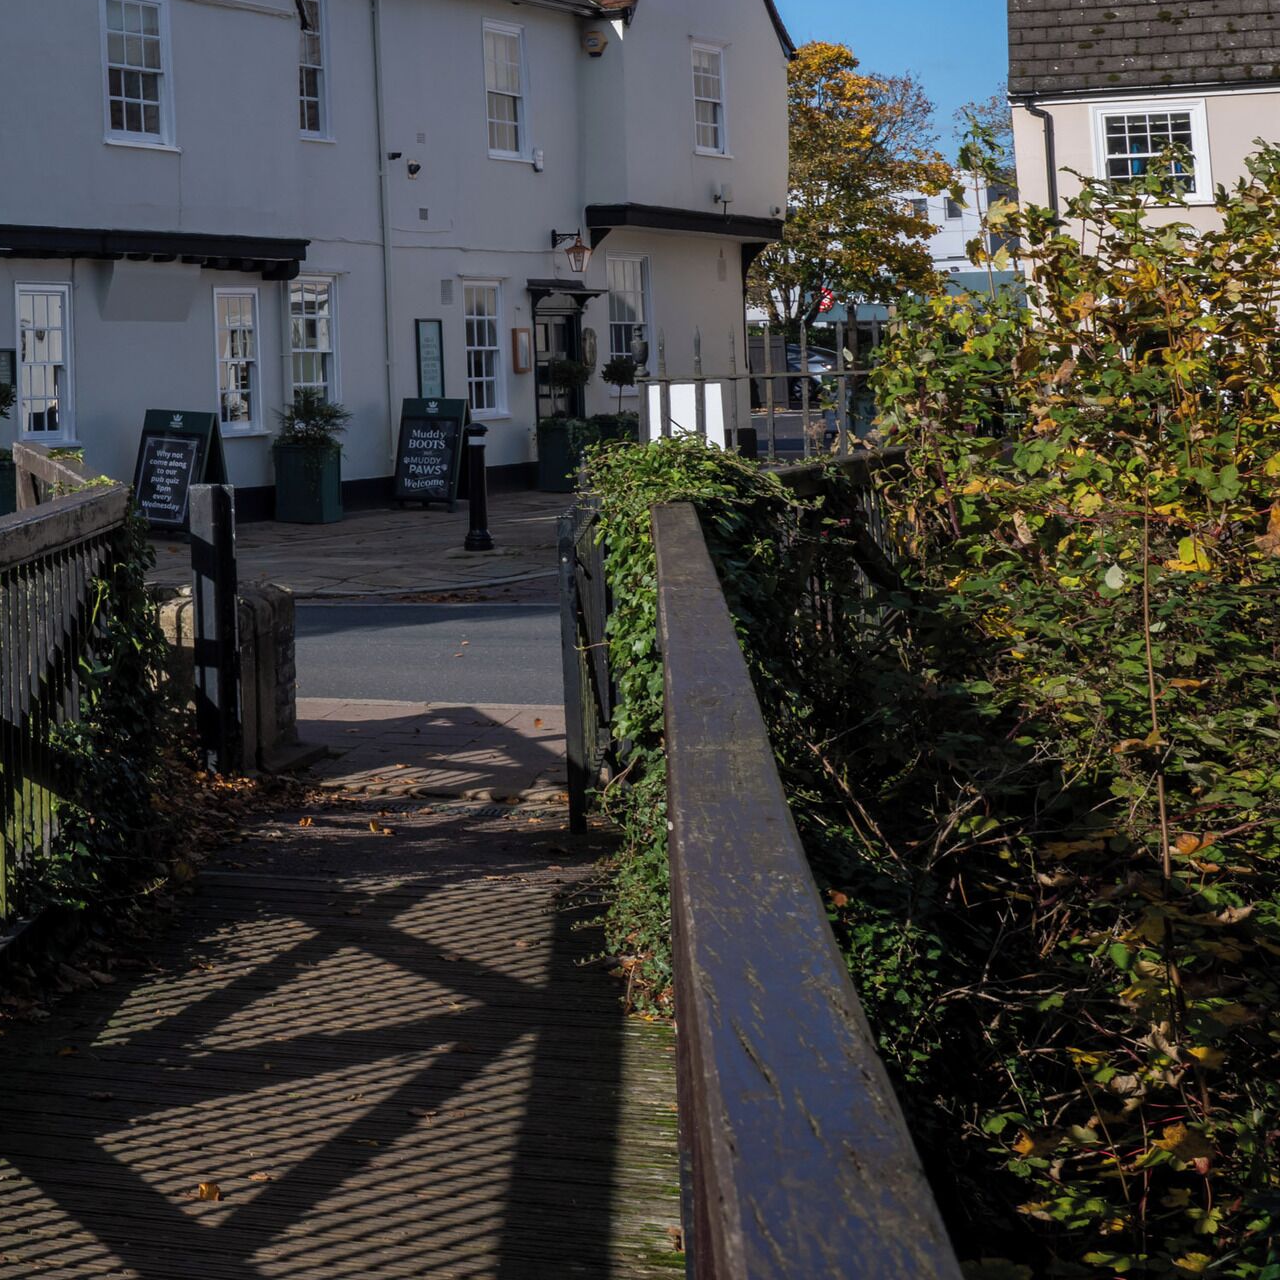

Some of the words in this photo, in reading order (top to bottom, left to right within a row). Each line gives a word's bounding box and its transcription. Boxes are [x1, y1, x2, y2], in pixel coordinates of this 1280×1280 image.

[412, 429, 446, 439] Muddy
[408, 439, 446, 449] BOOTS
[156, 450, 171, 459] Why
[169, 460, 187, 469] along
[410, 456, 442, 464] MUDDY
[409, 464, 441, 475] PAWS
[165, 477, 179, 485] quiz
[404, 478, 445, 488] Welcome
[152, 494, 172, 502] every
[142, 500, 180, 512] Wednesday
